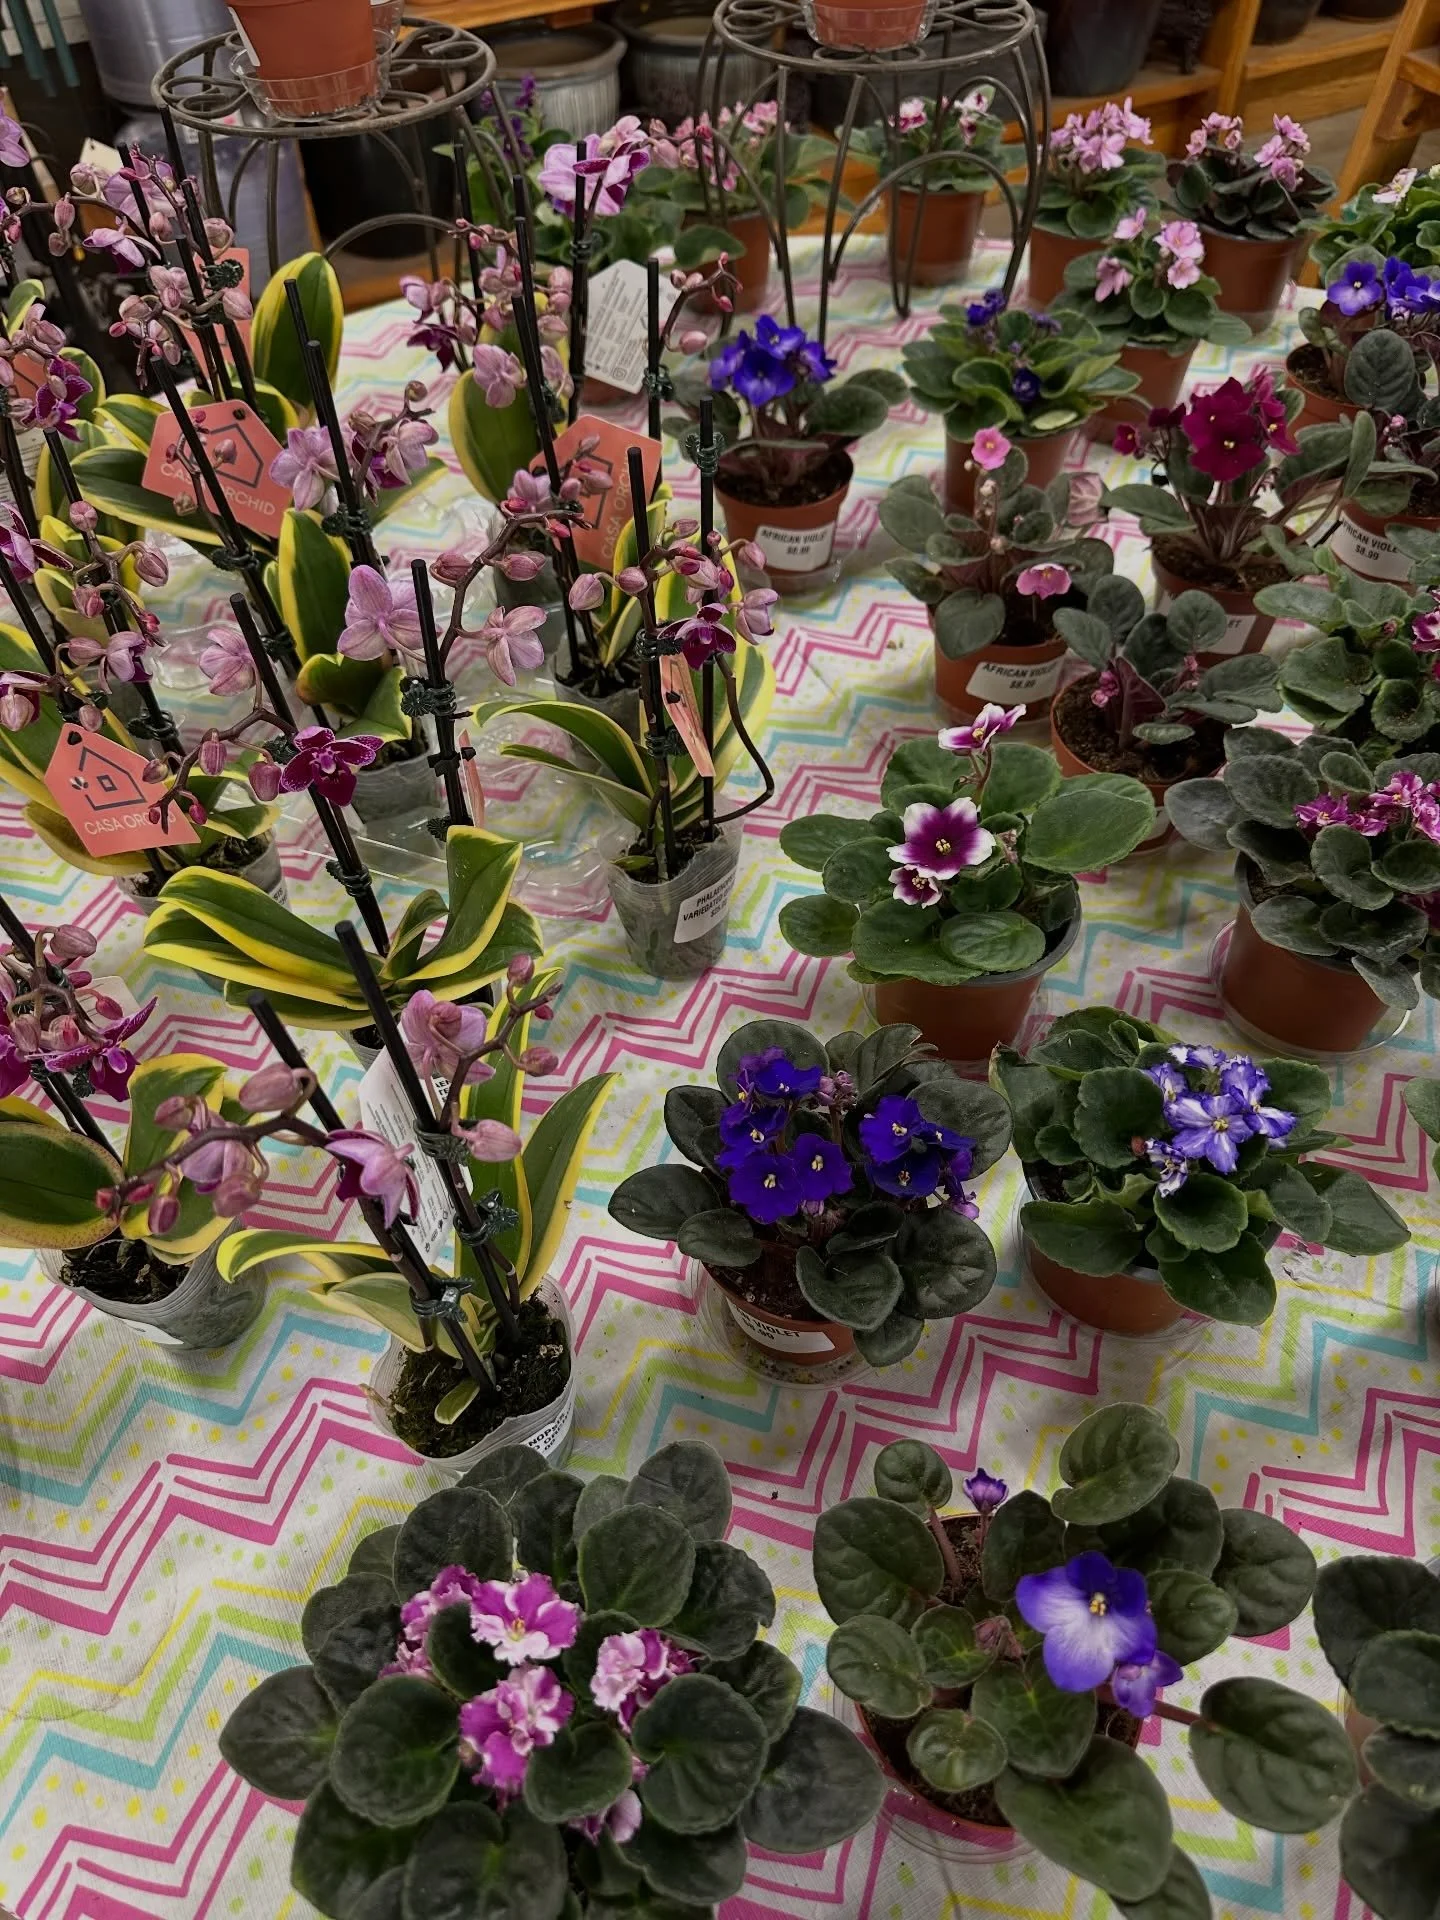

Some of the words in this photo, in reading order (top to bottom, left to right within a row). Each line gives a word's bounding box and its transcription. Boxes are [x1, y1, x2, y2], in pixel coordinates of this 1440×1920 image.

[223, 486, 276, 515] RCHID
[602, 517, 621, 558] CASA
[1355, 544, 1380, 560] $8.99
[983, 663, 1028, 677] AFRICAN
[84, 813, 124, 835] CASA
[752, 1319, 801, 1337] VIOLET
